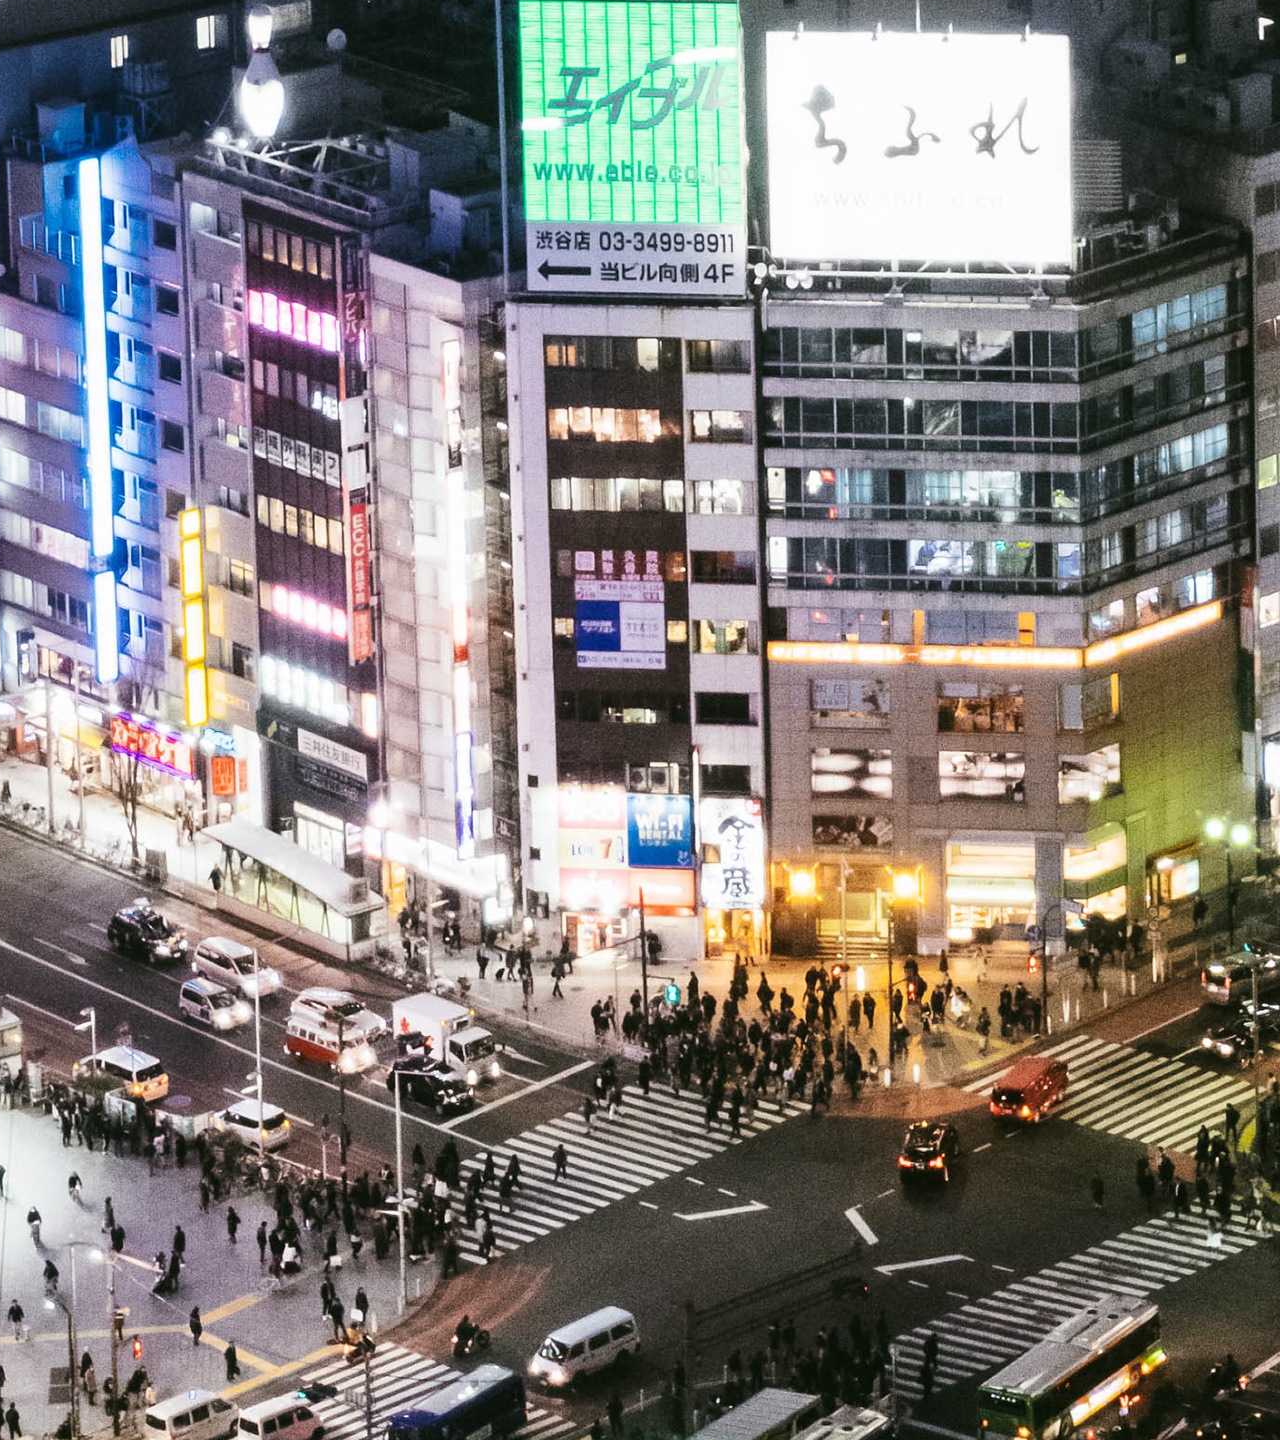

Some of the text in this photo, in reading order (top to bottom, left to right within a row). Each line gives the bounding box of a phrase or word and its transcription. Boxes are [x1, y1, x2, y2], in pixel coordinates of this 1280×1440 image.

[544, 48, 735, 130] エイブル
[801, 83, 1041, 166] ちふれ
[536, 230, 735, 253] 渋谷店 03-3499-8911
